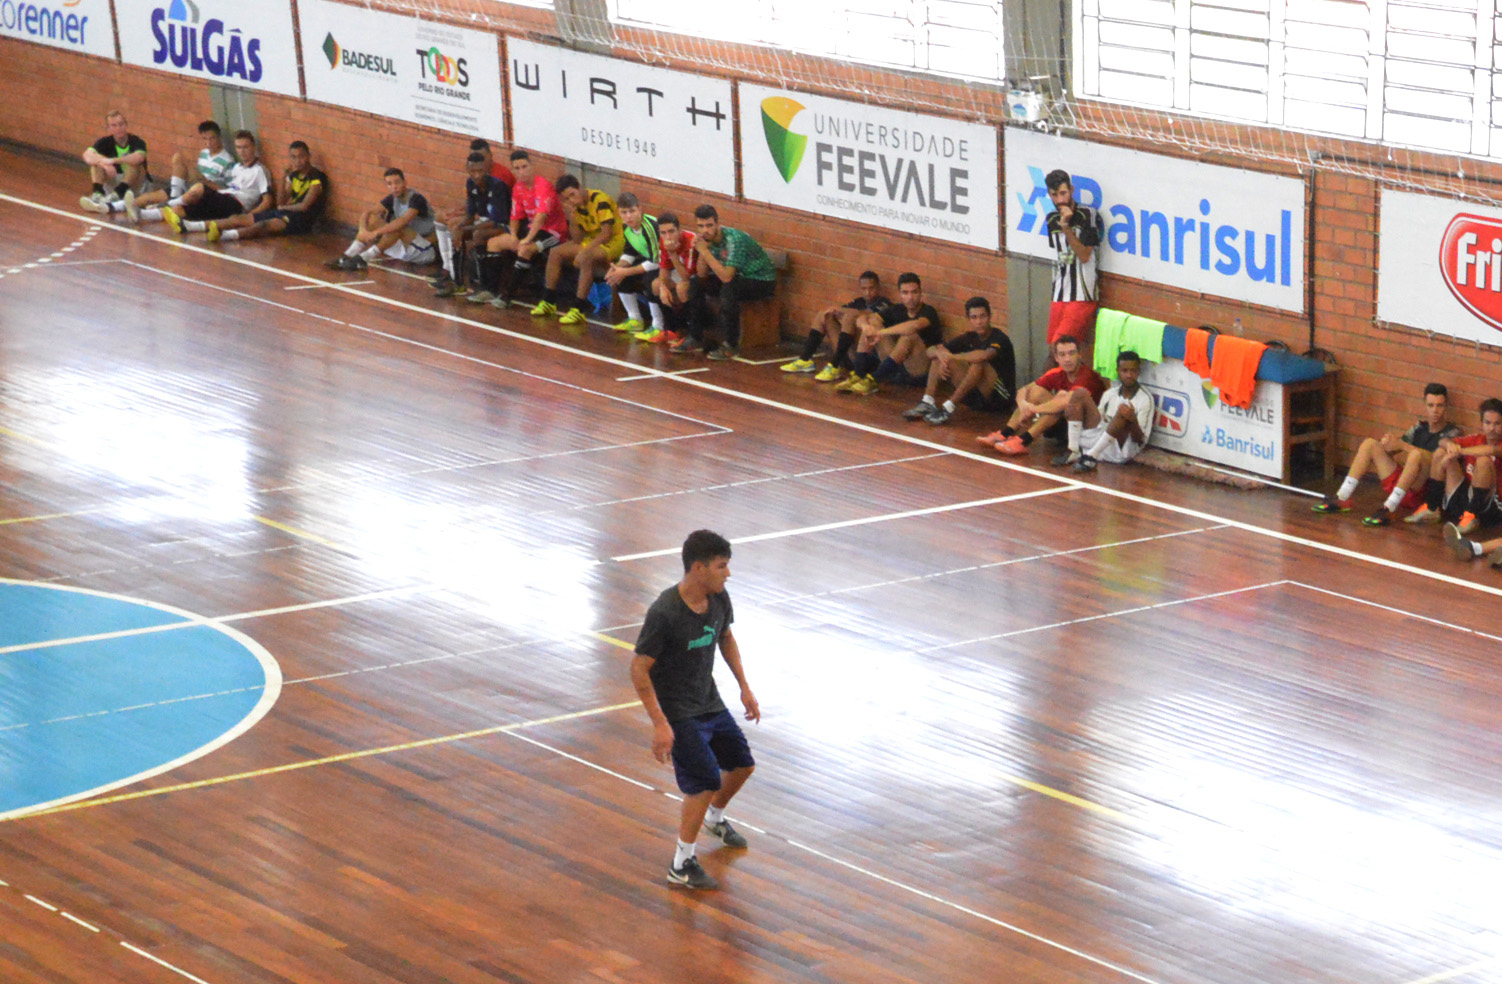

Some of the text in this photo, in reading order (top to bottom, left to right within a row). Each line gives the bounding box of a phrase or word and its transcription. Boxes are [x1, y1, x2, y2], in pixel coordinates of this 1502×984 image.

[0, 0, 89, 46] orenner
[341, 48, 397, 77] BADESUL
[415, 45, 470, 88] TODOS
[418, 82, 471, 101] PELO RIO GRANDE
[513, 58, 727, 131] WIRTH
[581, 126, 658, 159] DESDE 1948
[814, 112, 969, 162] UNIVERSIDADE
[815, 141, 970, 215] FEEVALE
[816, 194, 971, 235] CONHECIMENTO PARA INOVAR O MUNDO
[1216, 428, 1275, 461] Banrisul
